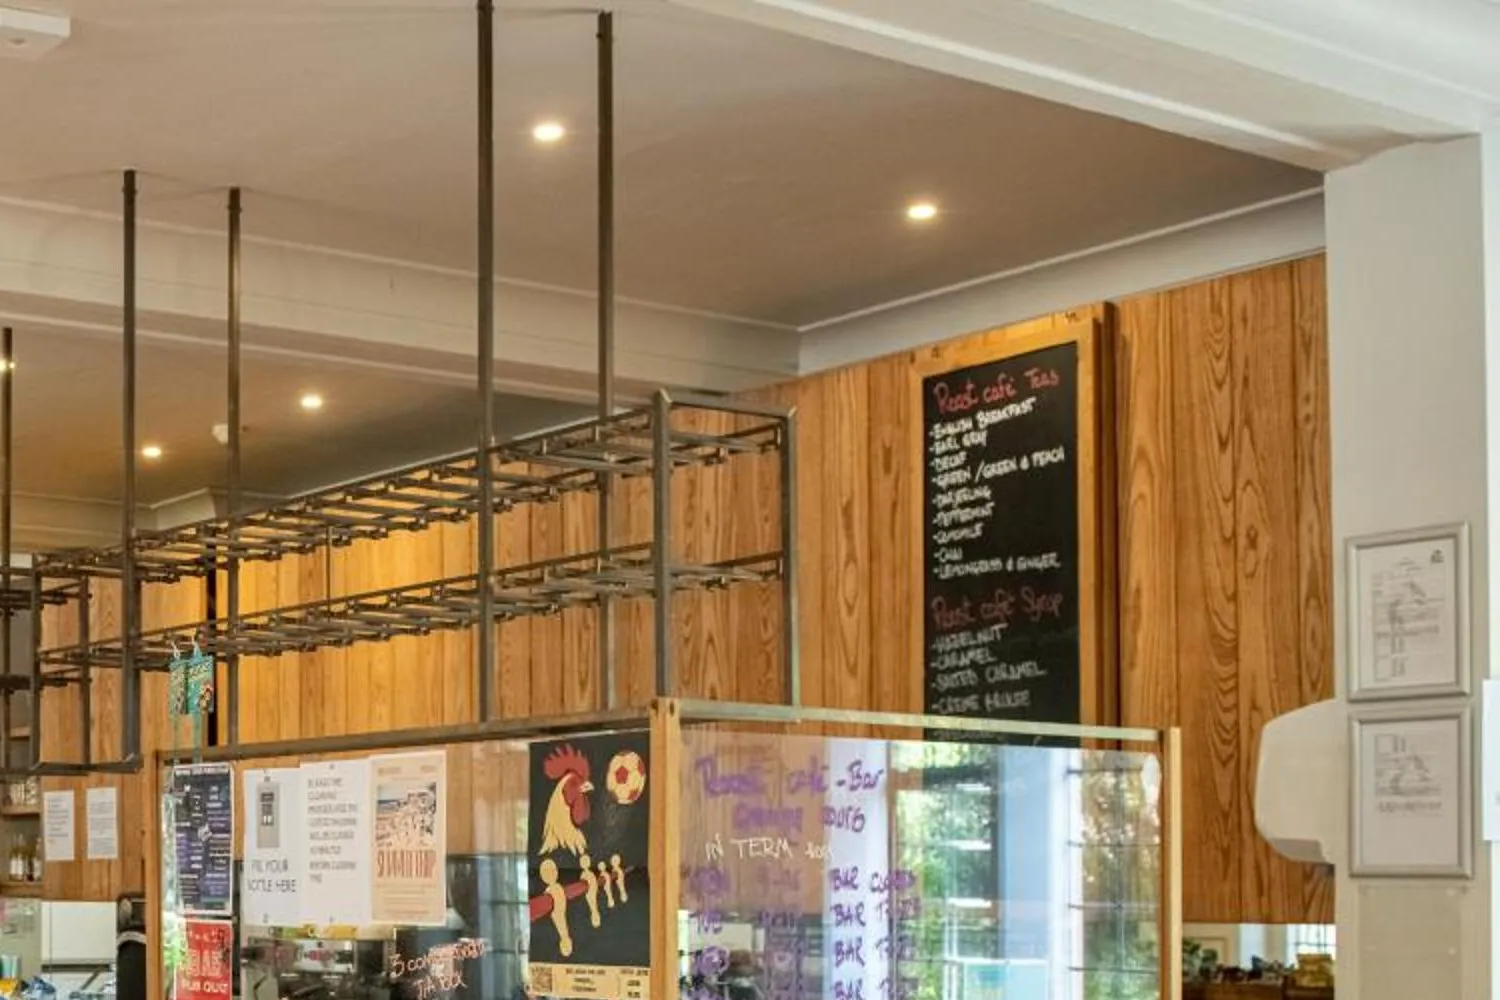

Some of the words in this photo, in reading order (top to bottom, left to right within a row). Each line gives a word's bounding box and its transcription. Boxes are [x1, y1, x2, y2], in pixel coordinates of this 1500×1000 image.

[985, 660, 1048, 684] CARAMEL
[730, 836, 793, 860] TERM
[834, 902, 866, 927] BAR
[835, 936, 866, 967] BAR
